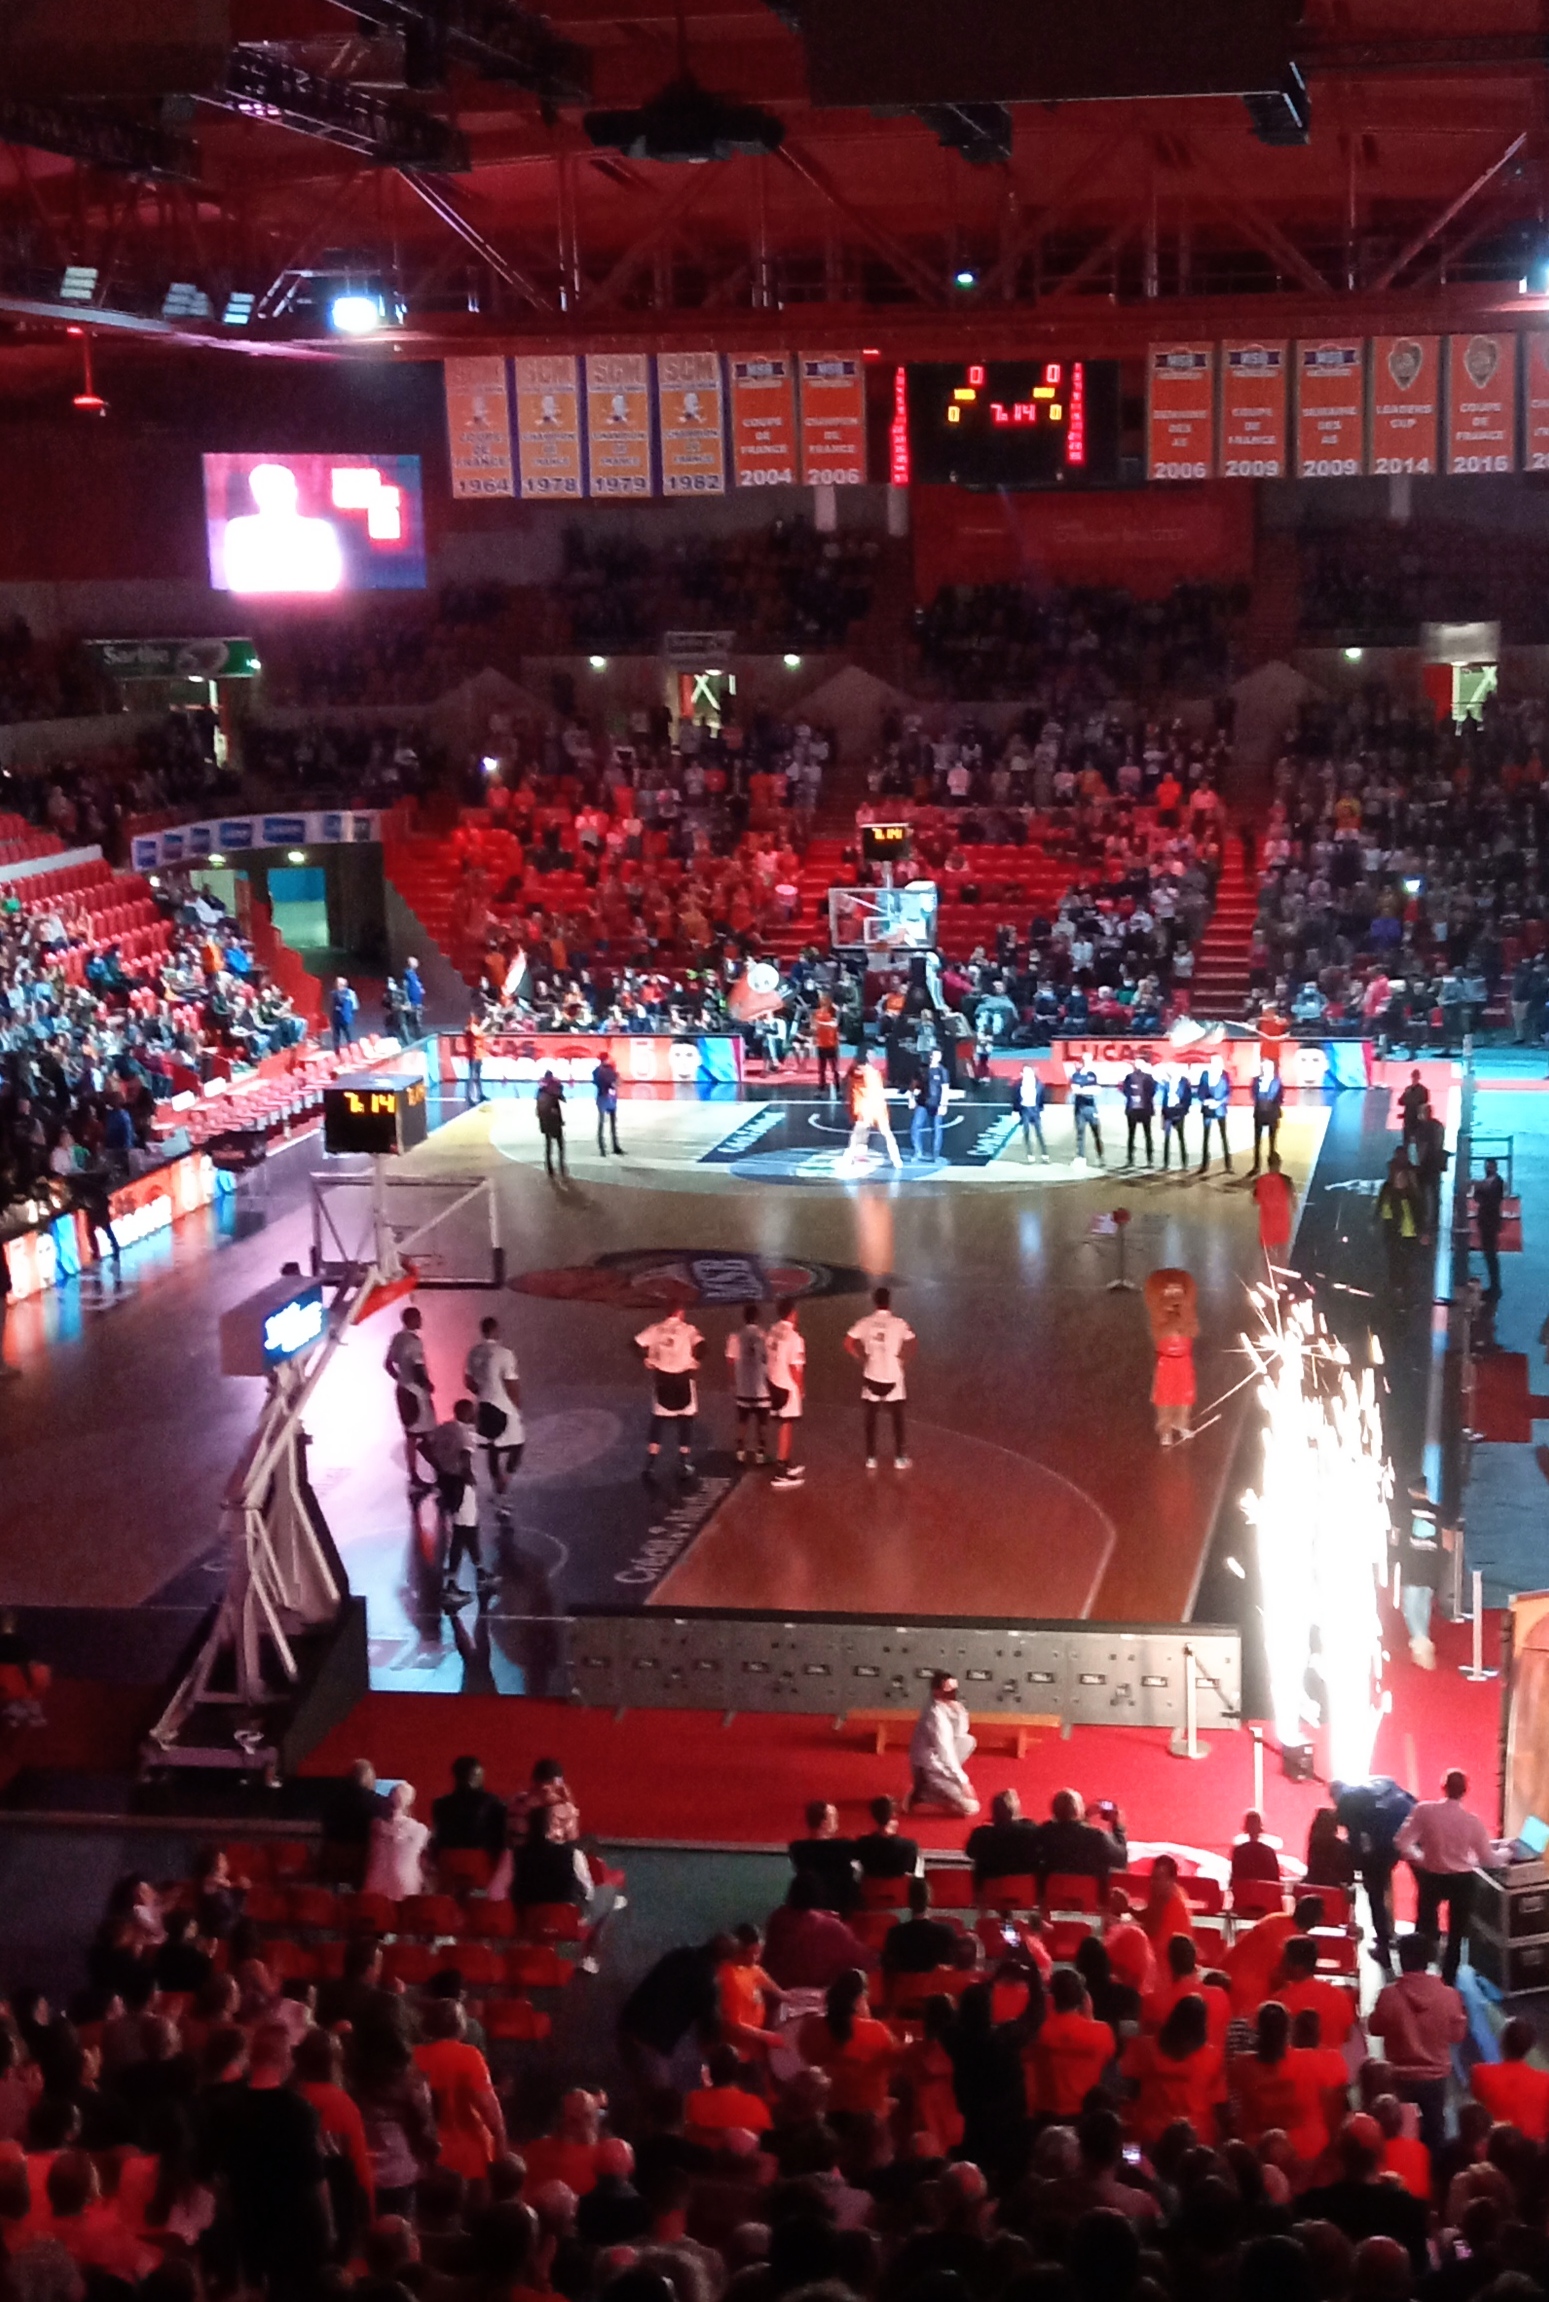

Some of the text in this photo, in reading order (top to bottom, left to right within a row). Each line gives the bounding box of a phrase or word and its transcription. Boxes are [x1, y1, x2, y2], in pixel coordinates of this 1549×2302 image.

[969, 366, 983, 384] 0
[1047, 364, 1060, 382] 0
[948, 406, 960, 422] 0
[1050, 404, 1062, 420] 0
[1153, 462, 1206, 479] 2006
[1225, 460, 1279, 477] 2009
[1303, 459, 1357, 476] 2009
[1374, 457, 1430, 474] 2014
[1453, 455, 1509, 473] 2016
[526, 477, 578, 492] 1978
[596, 476, 647, 492] 1979
[668, 474, 720, 490] 1982
[740, 468, 792, 486] 2004
[807, 468, 860, 484] 2006
[458, 478, 509, 493] 1964
